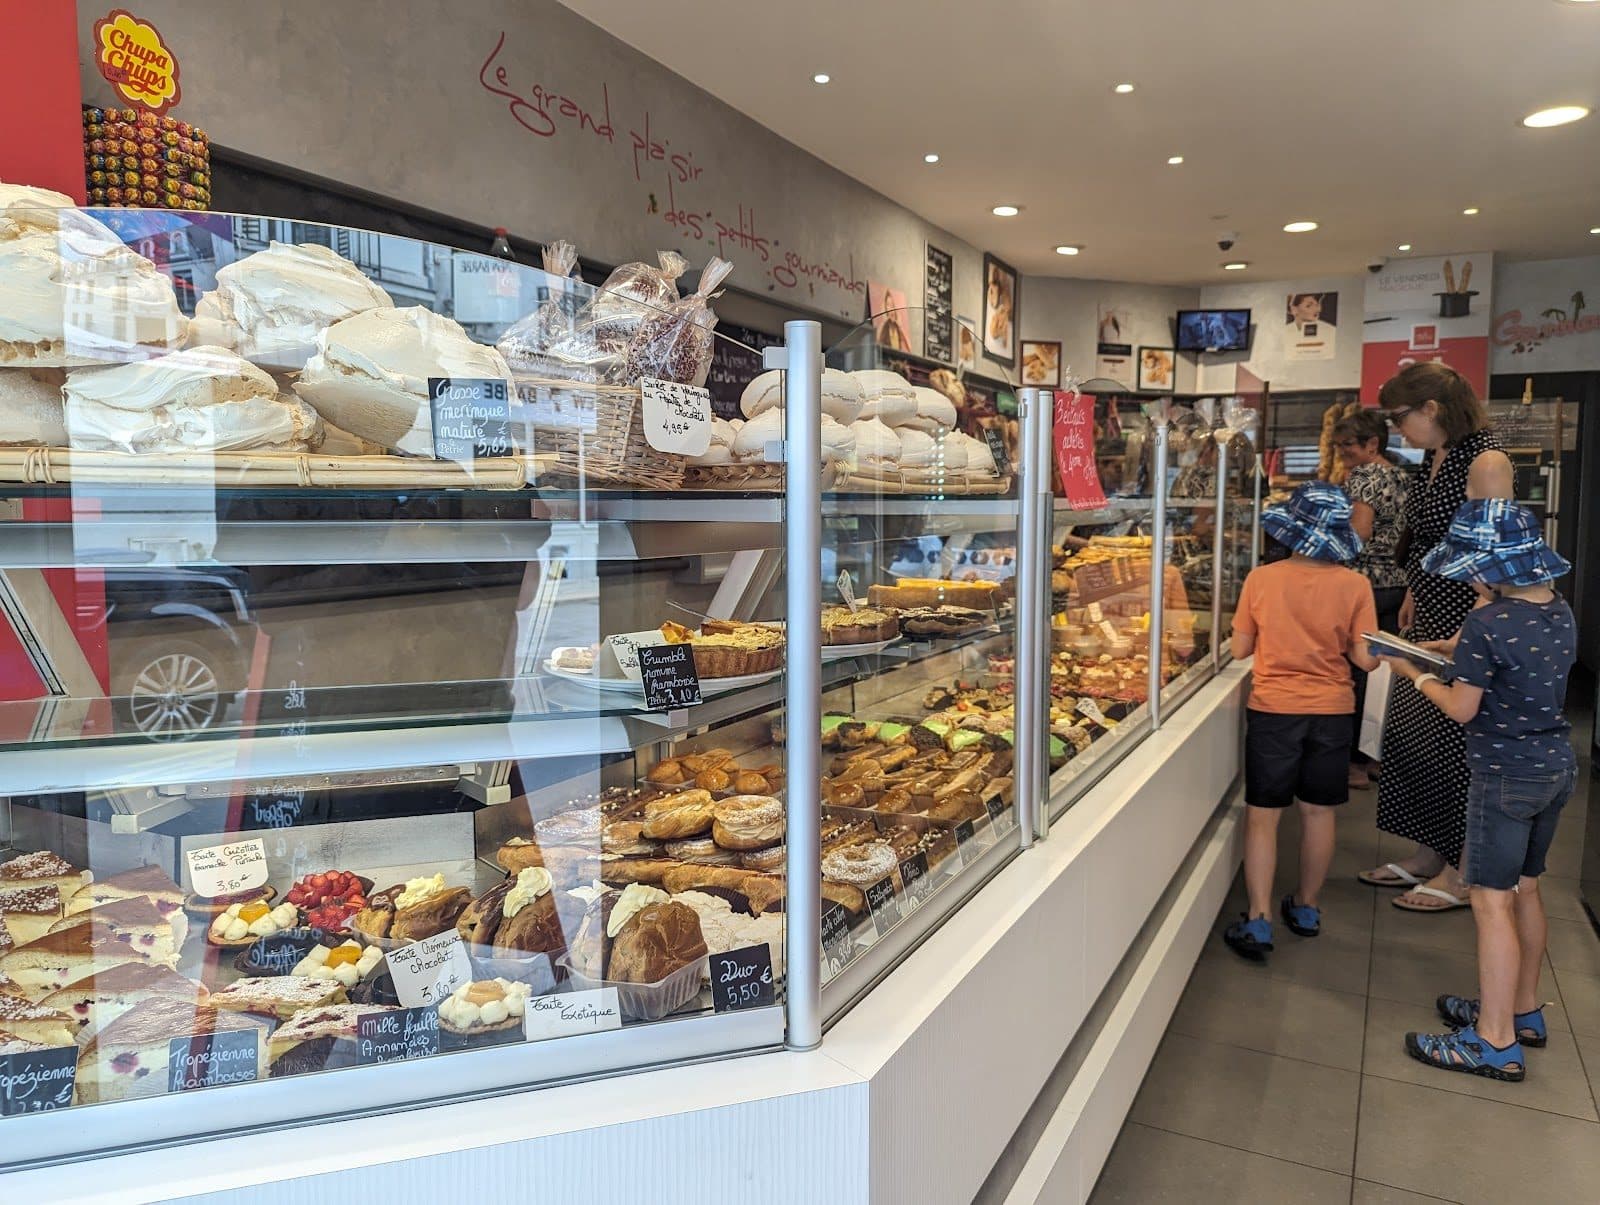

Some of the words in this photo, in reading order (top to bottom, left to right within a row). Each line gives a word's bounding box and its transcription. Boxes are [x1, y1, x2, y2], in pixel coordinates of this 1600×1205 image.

[109, 29, 169, 69] Chupa
[107, 50, 167, 90] Chups
[510, 82, 615, 142] grand
[630, 111, 703, 182] plaisir
[664, 173, 703, 240] des
[715, 202, 770, 261] petits
[773, 251, 866, 294] gourmands
[440, 403, 505, 428] meringue
[440, 420, 486, 439] nature
[477, 436, 507, 456] 5,65
[642, 646, 687, 665] Crumble
[643, 665, 678, 682] pomme
[389, 948, 417, 964] Tarte
[719, 959, 757, 984] Duo
[531, 996, 566, 1012] Tarte
[727, 982, 760, 1006] 5,50
[362, 1016, 401, 1037] Mille
[362, 1035, 430, 1057] Amandes
[169, 1043, 256, 1078] Tropézienne
[0, 1060, 76, 1101] opézienne
